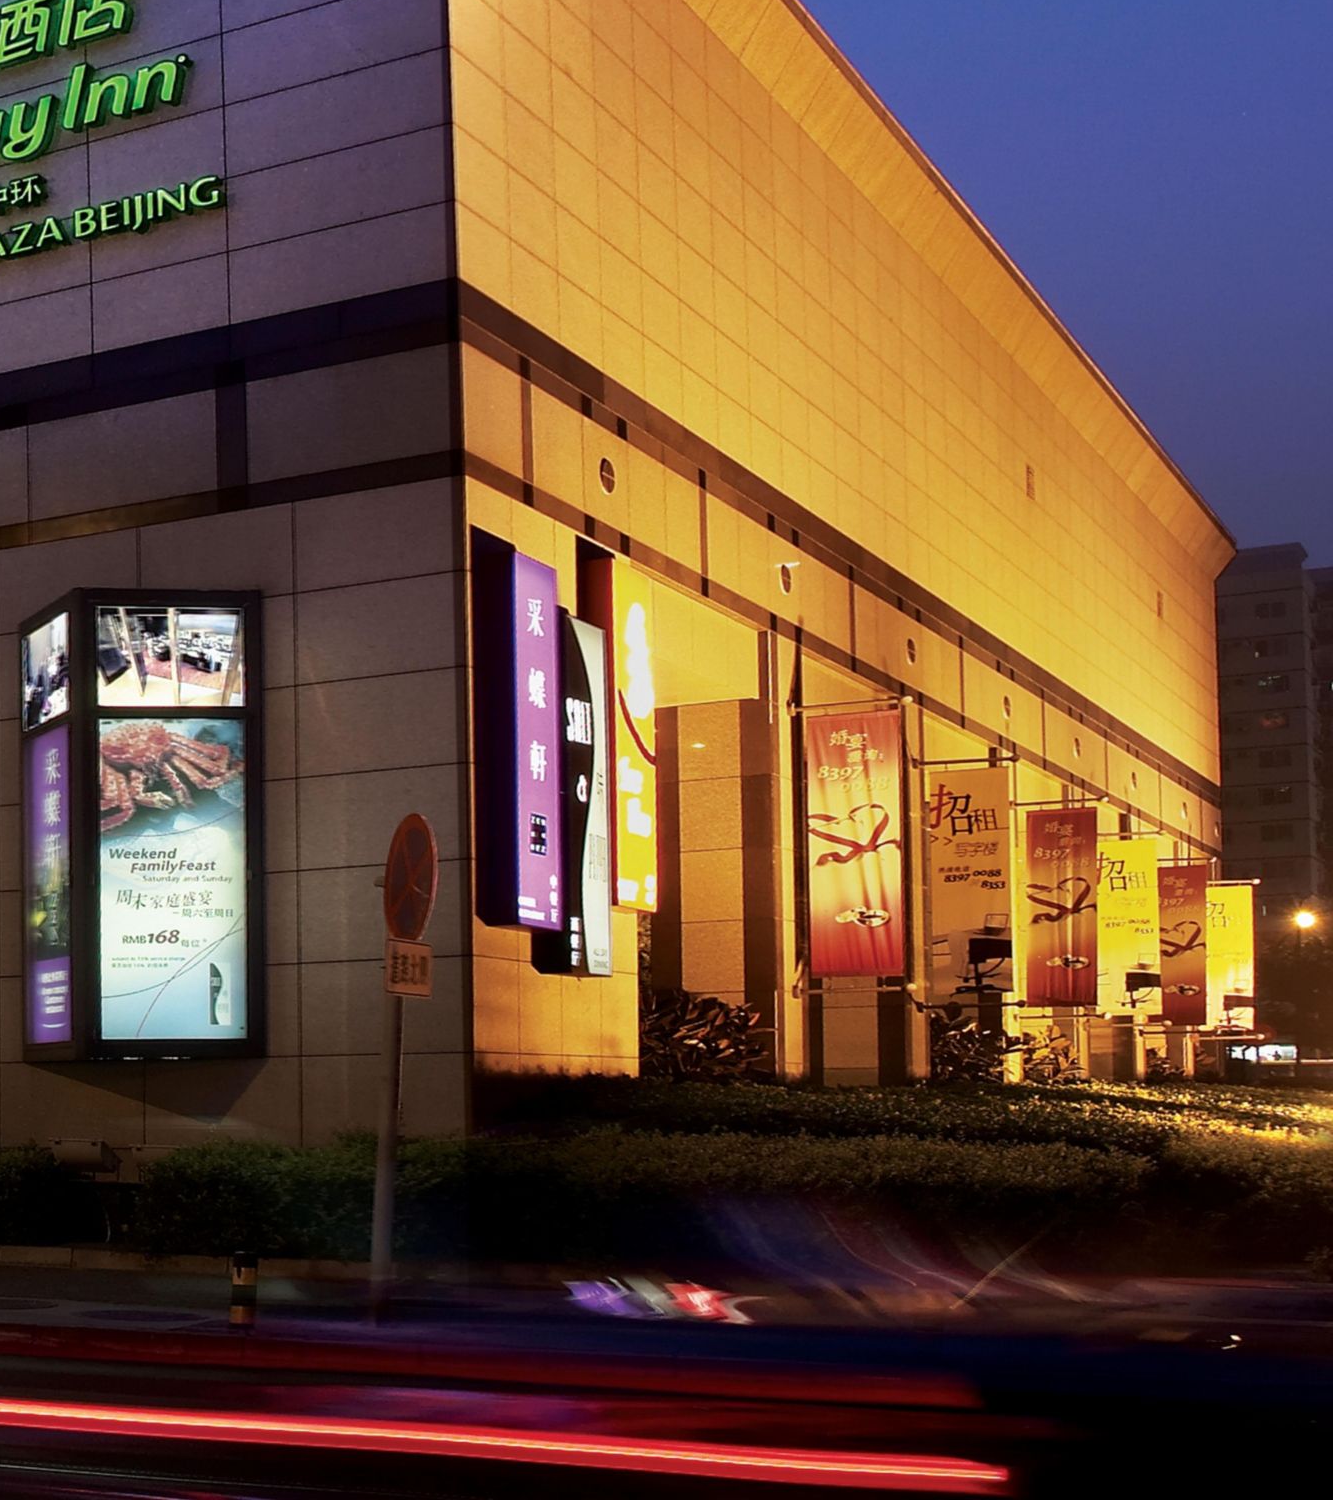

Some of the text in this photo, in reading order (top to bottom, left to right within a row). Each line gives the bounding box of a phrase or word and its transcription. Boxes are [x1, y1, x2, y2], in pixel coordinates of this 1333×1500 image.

[63, 55, 183, 130] Inn
[74, 176, 221, 238] BEIJING
[818, 765, 864, 781] 8397
[930, 783, 1009, 836] 招租
[108, 848, 178, 859] Weekend
[1034, 847, 1070, 860] 8397
[143, 875, 180, 884] Saturday
[202, 875, 233, 884] Sunday
[944, 873, 971, 883] 8397
